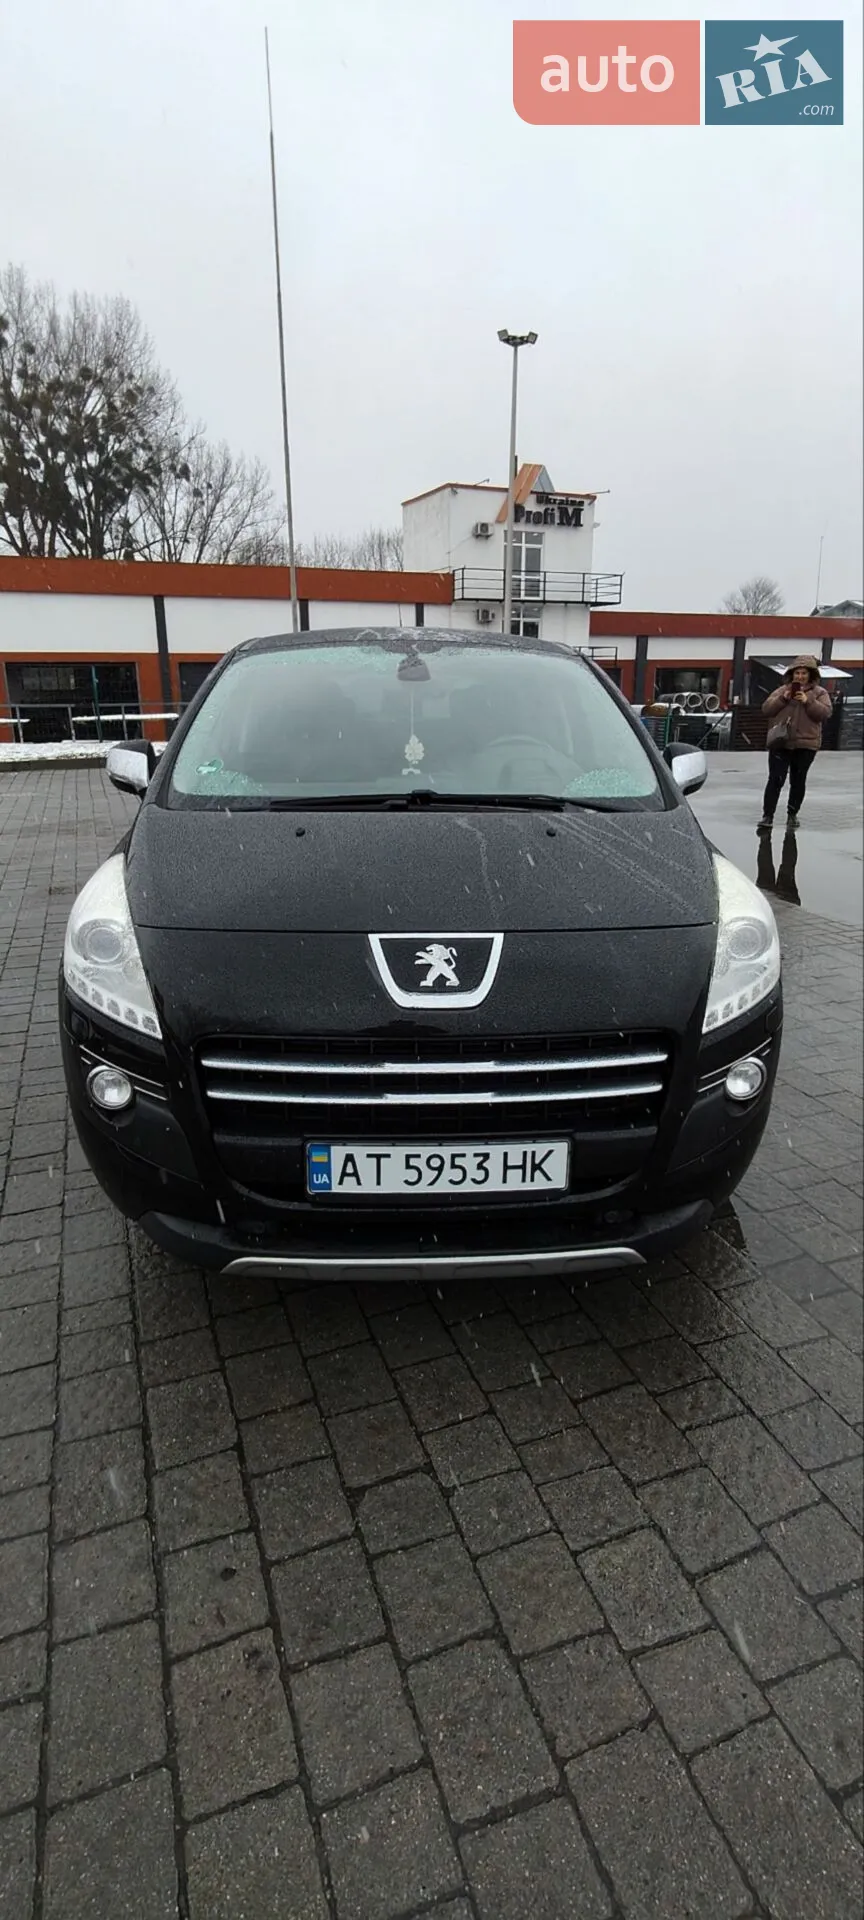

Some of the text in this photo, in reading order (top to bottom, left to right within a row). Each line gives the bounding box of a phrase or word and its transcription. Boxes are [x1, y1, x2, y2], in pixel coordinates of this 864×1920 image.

[536, 494, 585, 507] Ukraine
[337, 1149, 555, 1186] AT 5953 HK
[313, 1174, 330, 1185] UA
